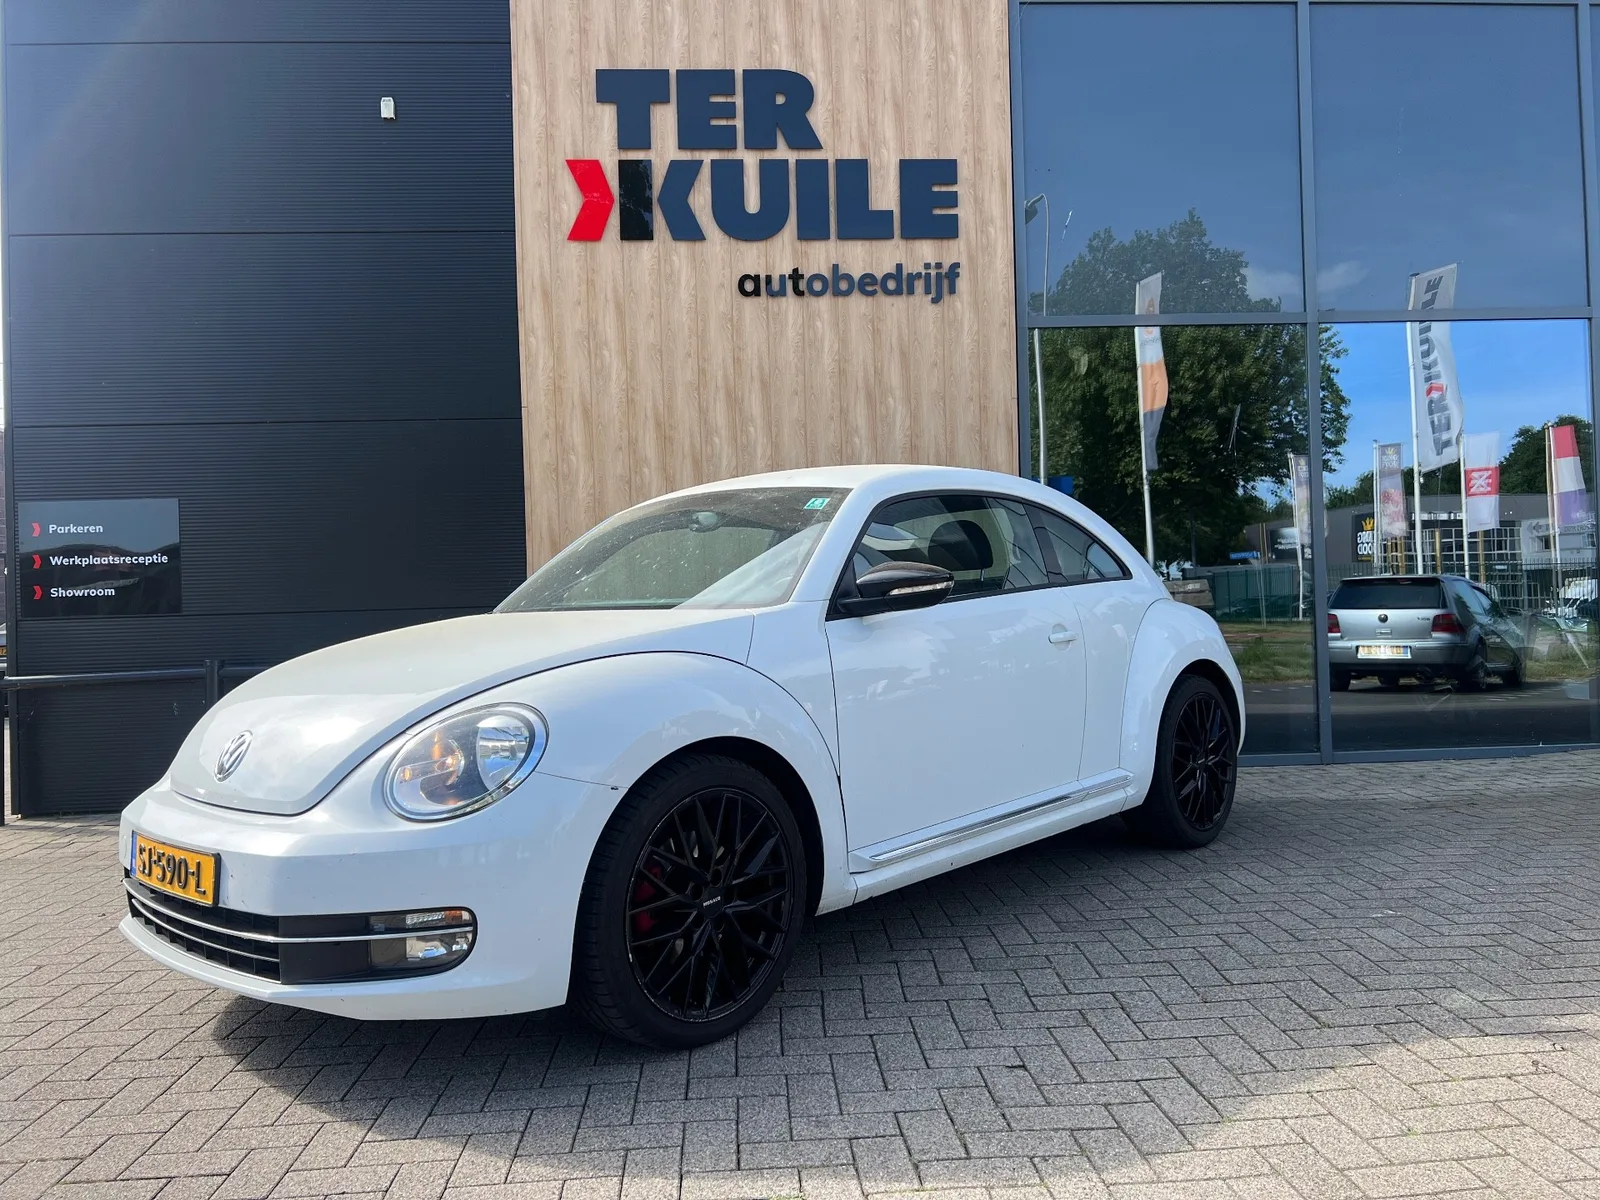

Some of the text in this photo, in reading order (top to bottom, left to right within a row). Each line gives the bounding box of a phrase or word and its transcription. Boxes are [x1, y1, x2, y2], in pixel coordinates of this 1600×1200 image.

[595, 69, 823, 149] TER
[618, 158, 959, 241] KUILE
[737, 262, 961, 304] autobedrijf
[49, 524, 104, 534] Parkeren
[49, 553, 169, 567] Werkplaatsreceptie
[50, 587, 116, 598] Showroom
[138, 843, 207, 896] SJ-590-L
